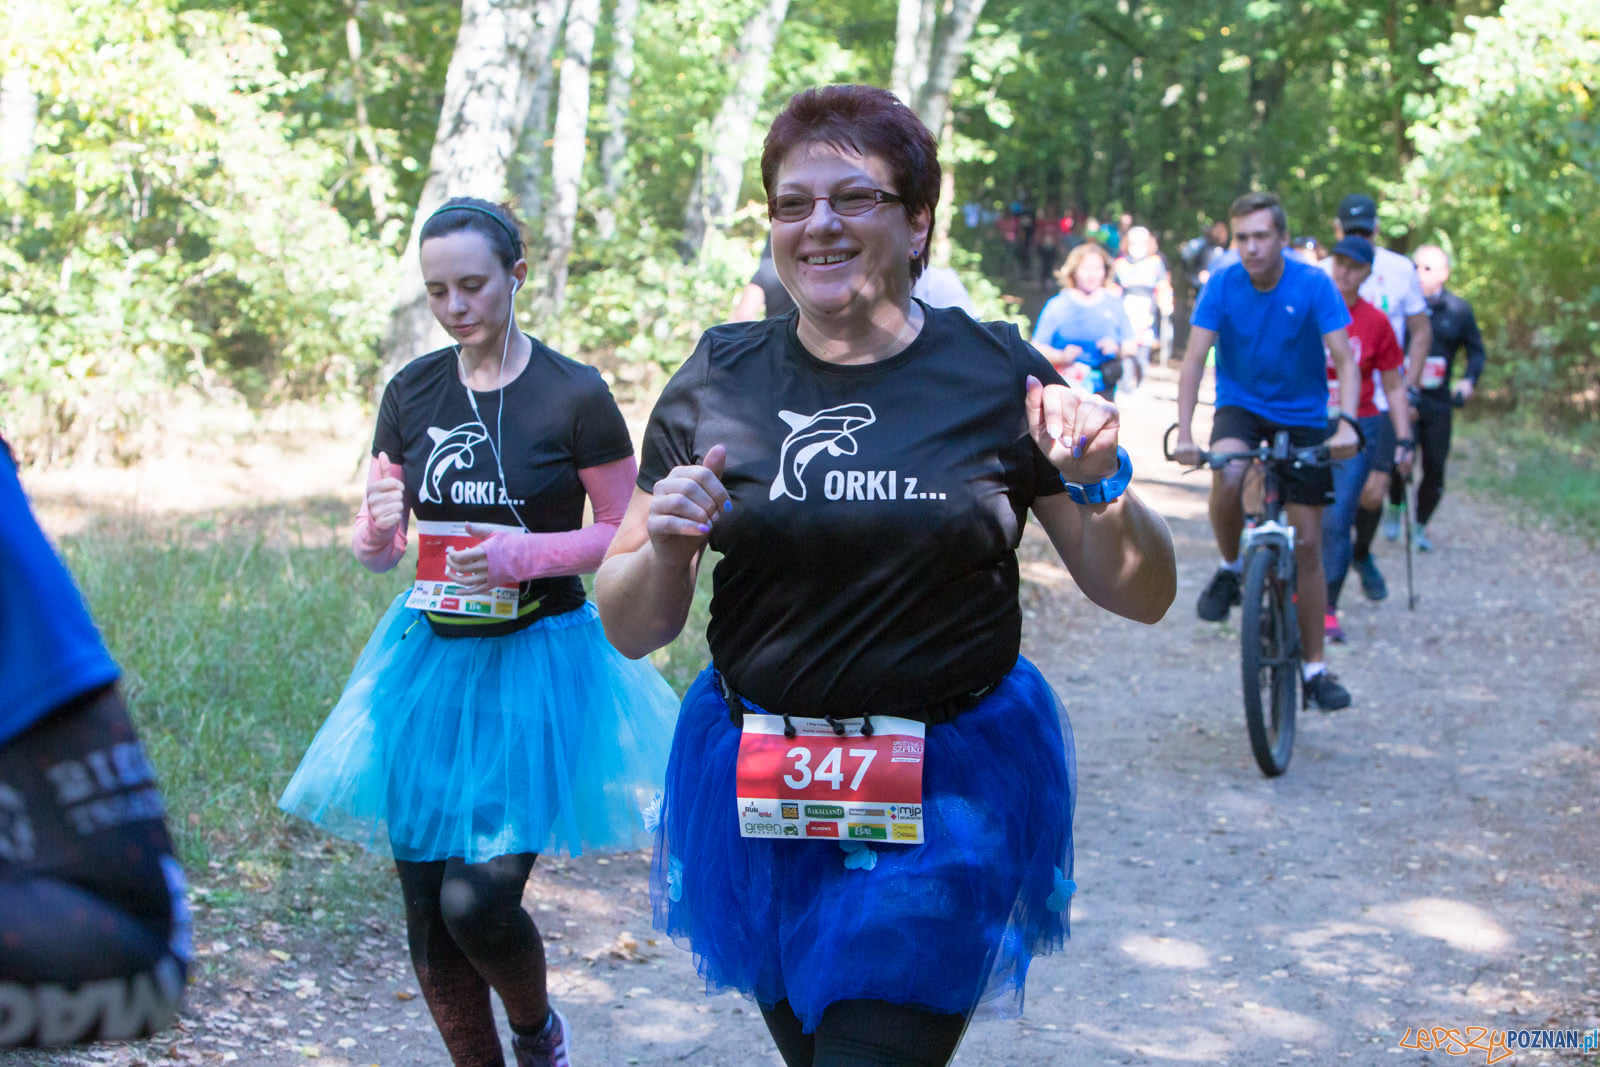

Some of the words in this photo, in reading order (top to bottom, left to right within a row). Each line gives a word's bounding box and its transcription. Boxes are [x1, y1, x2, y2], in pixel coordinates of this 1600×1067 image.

[450, 480, 495, 505] ORKI
[824, 470, 897, 501] ORKI
[904, 477, 947, 500] z...
[783, 747, 878, 791] 347
[745, 822, 782, 834] green
